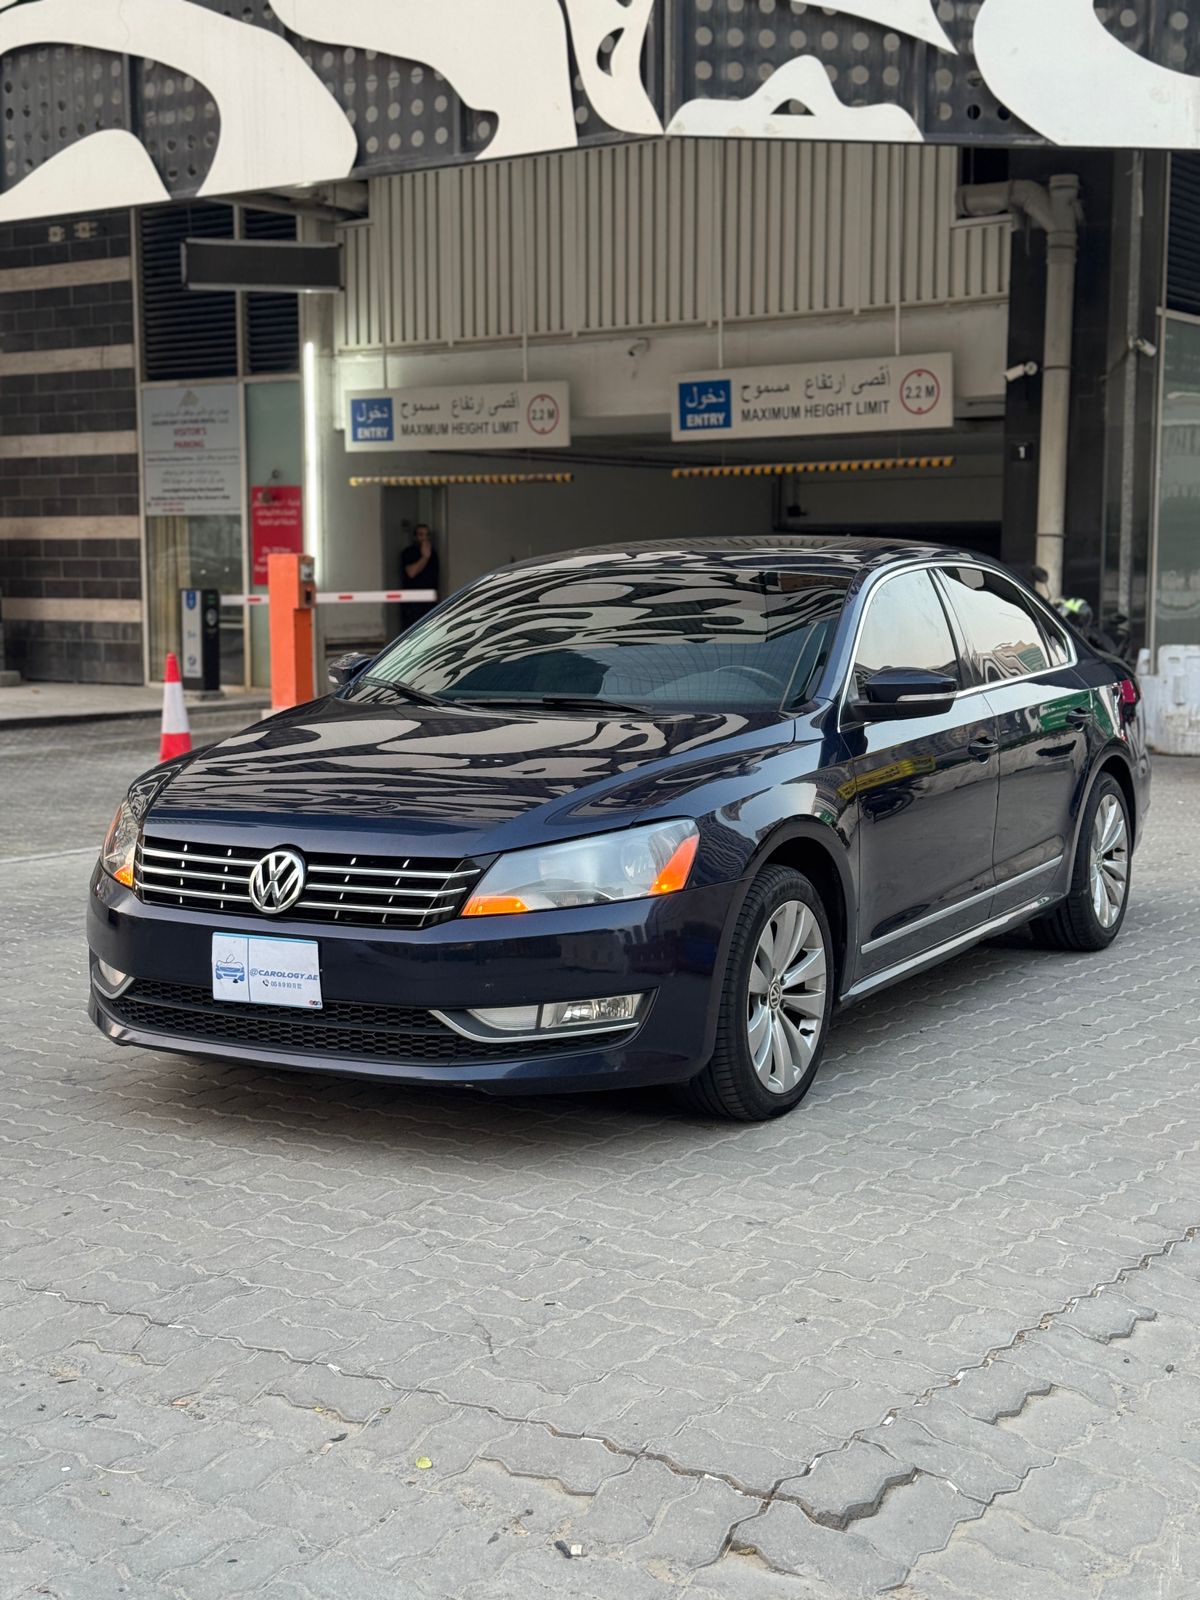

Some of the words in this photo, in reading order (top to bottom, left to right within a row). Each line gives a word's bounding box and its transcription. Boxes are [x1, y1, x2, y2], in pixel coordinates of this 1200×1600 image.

[804, 372, 846, 399] ارتفاع
[852, 365, 891, 395] أقصى
[685, 386, 726, 409] دخول
[740, 382, 790, 402] مسموح
[905, 386, 922, 399] 2.2
[925, 384, 936, 398] M
[356, 402, 389, 423] دخول
[401, 402, 440, 419] مسموح
[451, 394, 484, 417] ارتفاع
[489, 391, 519, 416] أقصى
[741, 405, 800, 422] MAXIMUM
[804, 402, 852, 418] HEIGHT
[856, 400, 890, 416] LIMIT
[531, 409, 545, 421] 2.2
[546, 408, 556, 420] M
[686, 412, 725, 427] ENTRY
[357, 426, 389, 440] ENTRY
[401, 422, 449, 436] MAXIMUM
[451, 421, 489, 435] HEIGHT
[492, 420, 519, 434] LIMIT
[1018, 446, 1025, 459] 1
[249, 968, 319, 981] @CAROLOGY.AE
